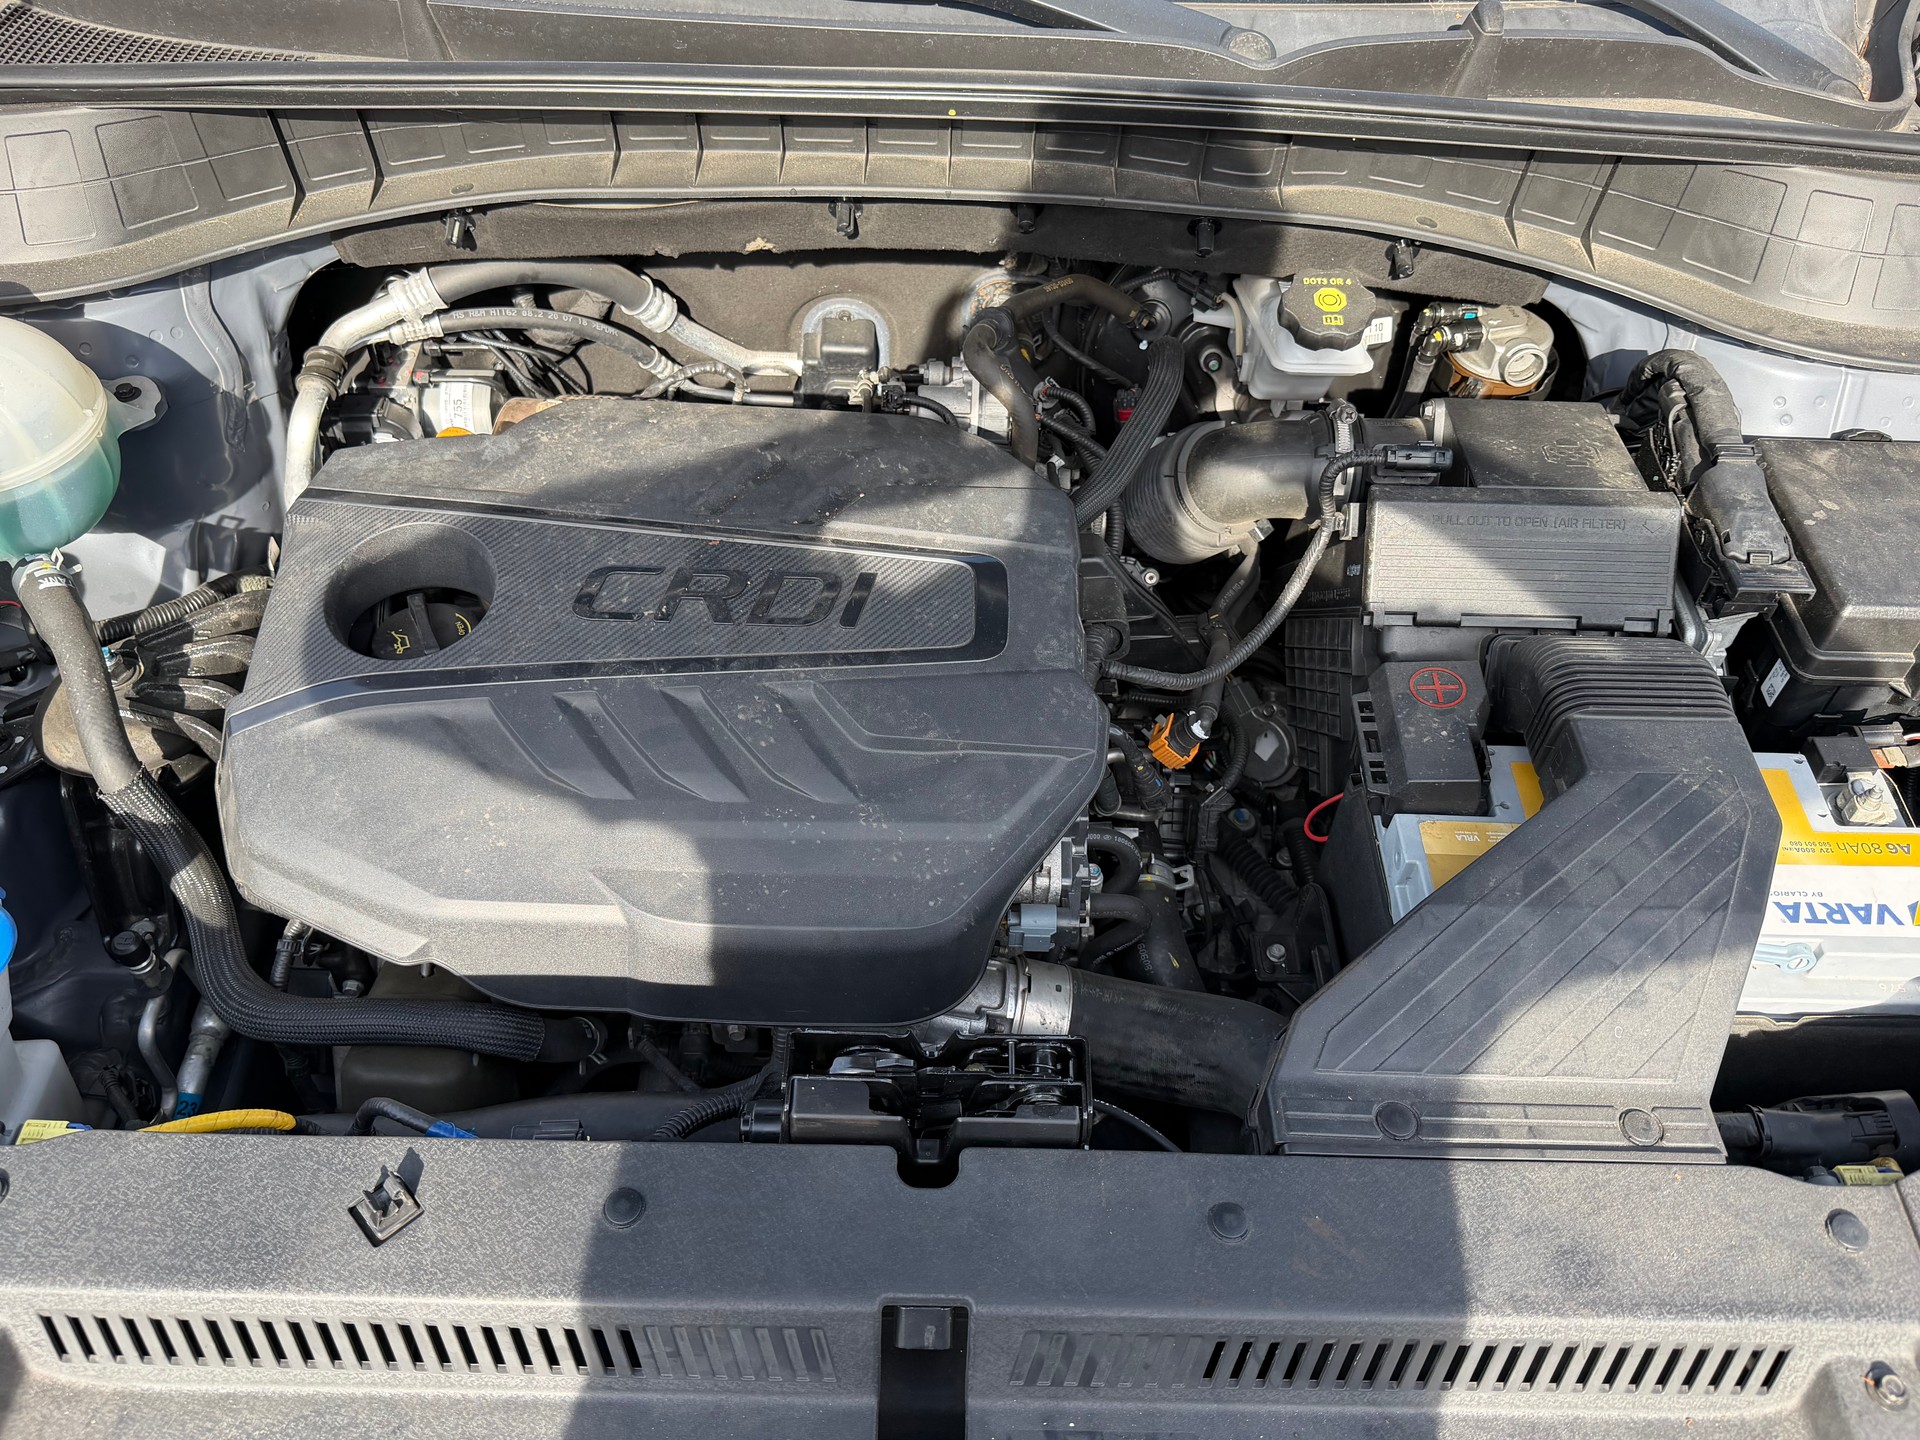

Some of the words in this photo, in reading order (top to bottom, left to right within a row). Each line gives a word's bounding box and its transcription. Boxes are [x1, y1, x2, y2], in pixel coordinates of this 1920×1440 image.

[1303, 277, 1327, 285] DOT3
[1329, 277, 1343, 285] OR
[453, 399, 463, 419] 755
[1433, 514, 1461, 526] PULL
[1466, 515, 1492, 526] OUT
[1495, 515, 1511, 527] TO
[1514, 516, 1548, 528] OPEN
[37, 576, 75, 590] TANK
[572, 566, 878, 629] CRDI
[1455, 834, 1480, 842] VRLA
[1836, 842, 1883, 854] 80Ah
[1885, 843, 1911, 855] A6
[1772, 901, 1905, 926] VARTA
[1879, 983, 1906, 993] 576
[176, 1100, 198, 1116] 23
